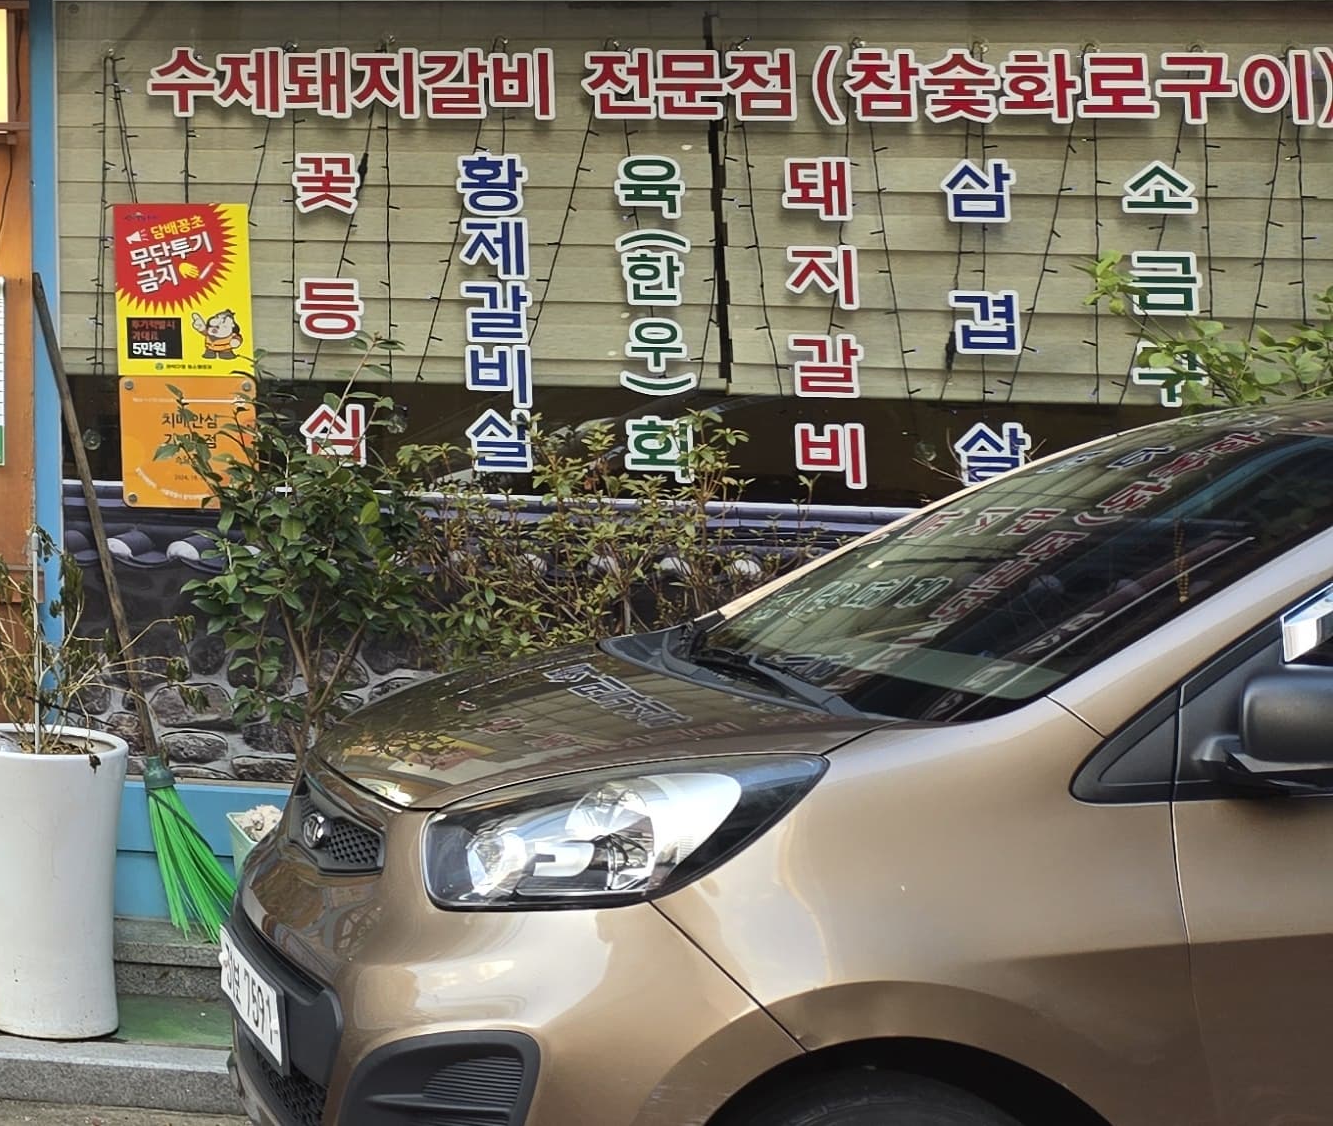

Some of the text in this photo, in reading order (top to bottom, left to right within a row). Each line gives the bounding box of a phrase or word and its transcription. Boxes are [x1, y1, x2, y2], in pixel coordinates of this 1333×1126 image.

[148, 45, 556, 121] 수제돼지갈비
[581, 46, 798, 123] 전문점
[150, 215, 206, 239] 담배꽁초
[129, 231, 213, 270] 무단투기
[136, 264, 180, 294] 금지
[132, 342, 166, 356] 5만원
